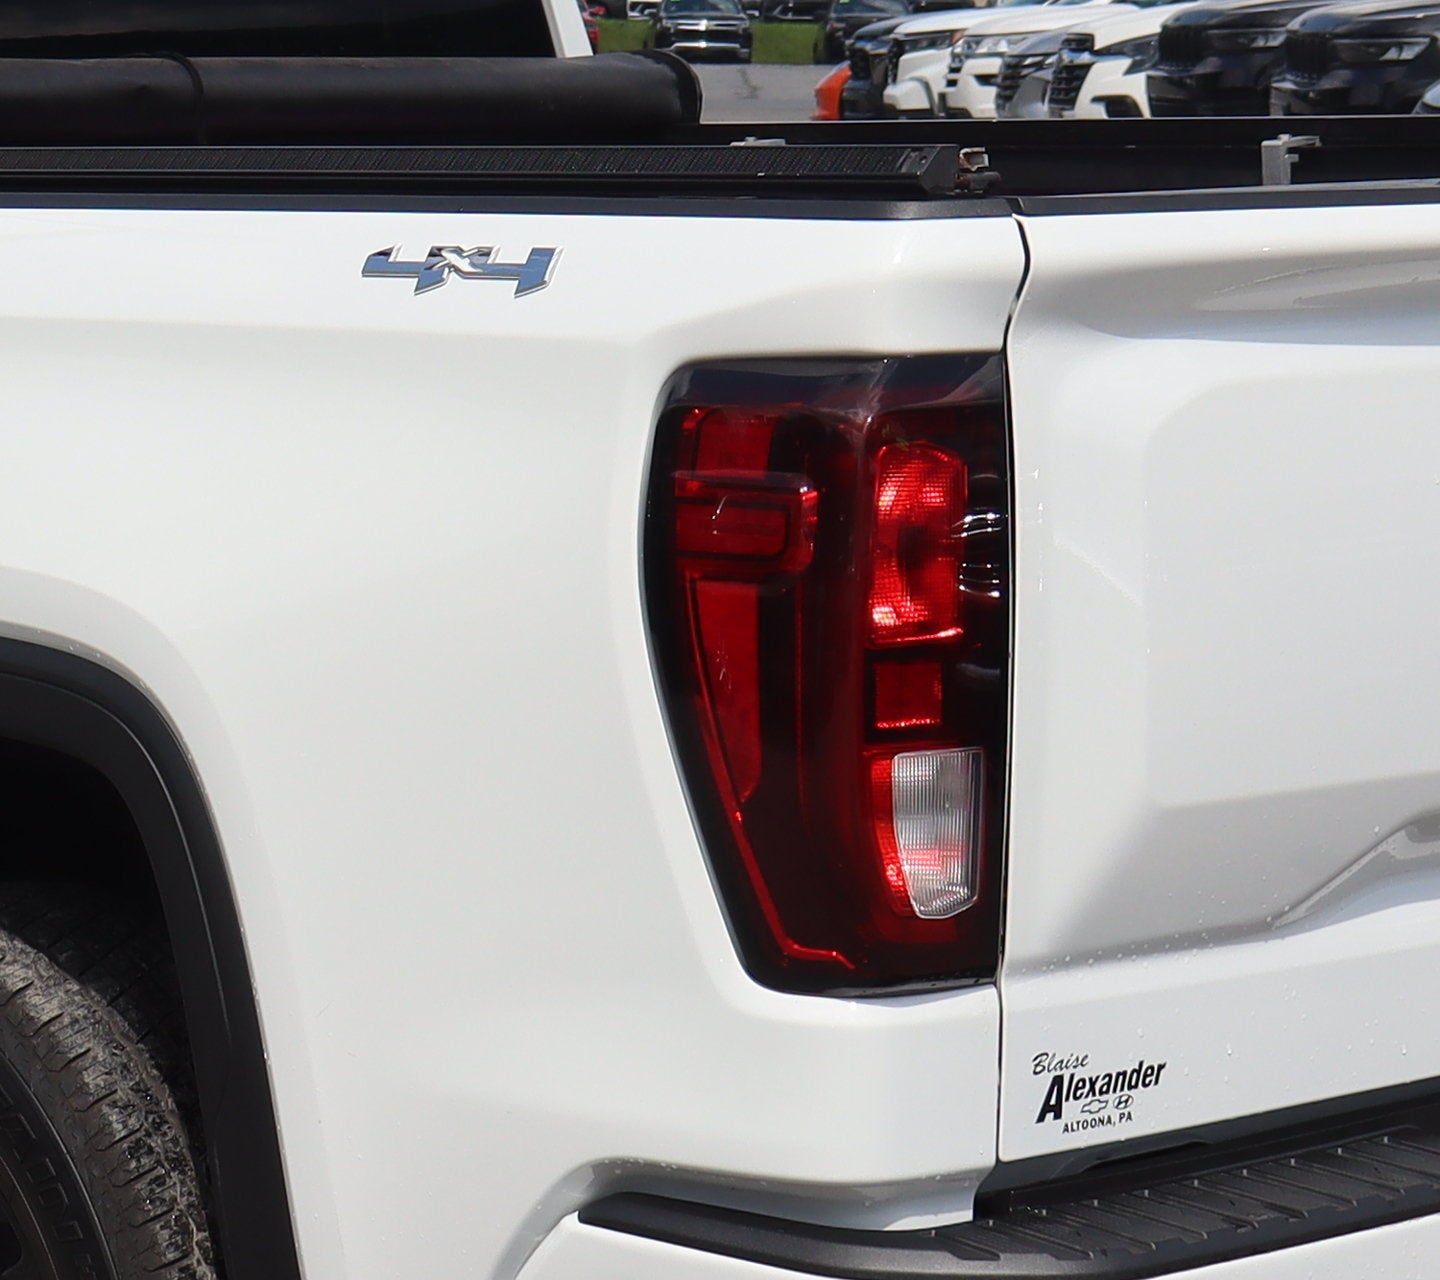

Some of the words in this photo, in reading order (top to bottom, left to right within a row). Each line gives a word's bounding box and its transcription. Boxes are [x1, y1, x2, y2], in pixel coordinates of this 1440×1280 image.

[1032, 1052, 1089, 1076] Blaise
[1035, 1060, 1167, 1124] Alexander
[1062, 1115, 1116, 1134] ALTOONA,
[1119, 1111, 1133, 1123] PA
